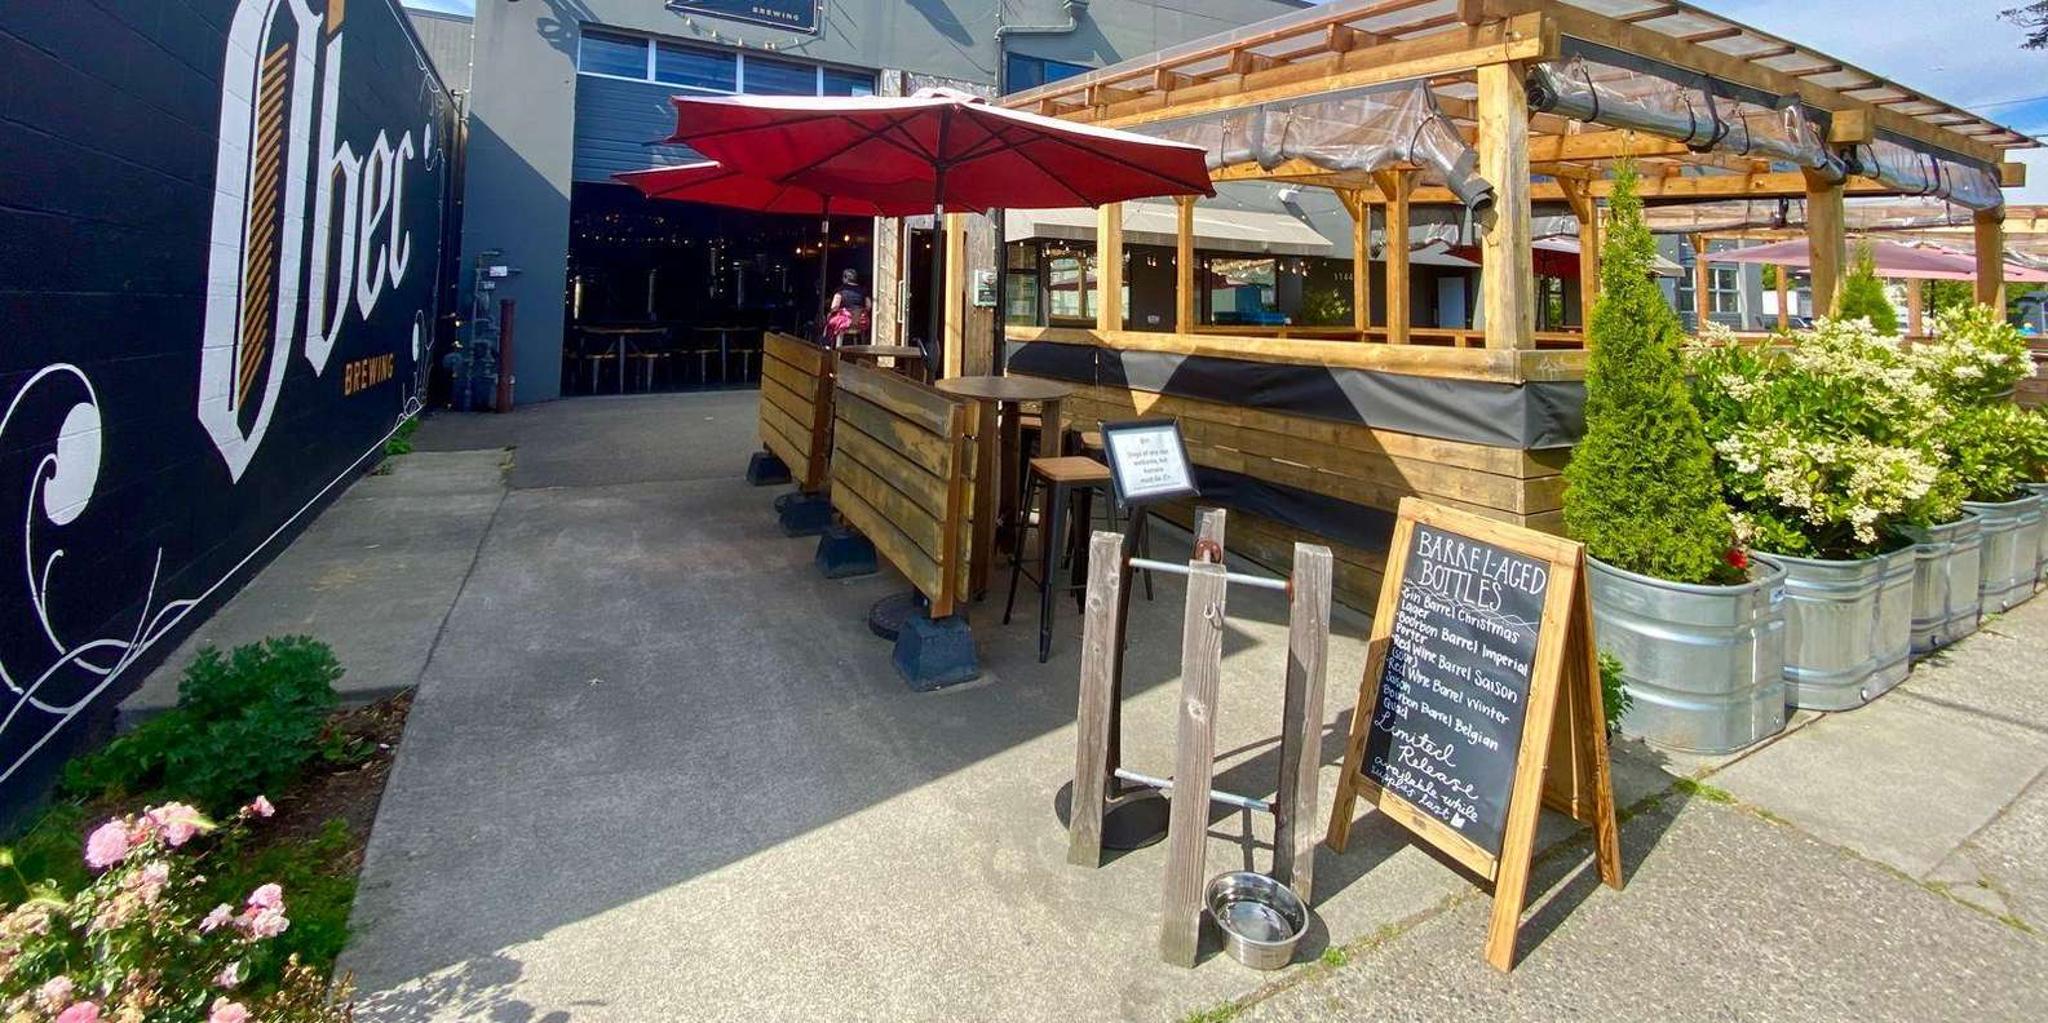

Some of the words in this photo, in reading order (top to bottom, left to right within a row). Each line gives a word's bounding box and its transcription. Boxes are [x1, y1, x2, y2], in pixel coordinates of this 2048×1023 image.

[752, 7, 799, 21] BREWING
[344, 353, 393, 396] BREWING
[1417, 530, 1547, 595] BARREL-AGED
[1420, 559, 1502, 612] BOTTLES
[1396, 622, 1429, 644] Porter
[1401, 598, 1430, 619] Lager
[1401, 586, 1421, 604] Gin
[1424, 594, 1456, 619] Barrel
[1458, 609, 1521, 644] Christmas
[1412, 642, 1437, 663] Wine
[1438, 654, 1471, 681] Barrel
[1474, 669, 1518, 703] Saison
[1441, 627, 1478, 653] Barrel
[1482, 643, 1529, 677] Imperial
[1383, 698, 1408, 720] Quad
[1388, 657, 1406, 677] Red
[1408, 667, 1431, 688] Wine
[1432, 679, 1463, 703] Barrel
[1467, 697, 1510, 724] Winter
[1374, 712, 1456, 767] Limited
[1384, 684, 1419, 710] Bourbon
[1421, 702, 1452, 727] Barrel
[1455, 718, 1499, 751] Belgian
[1398, 745, 1479, 800] Release
[1418, 794, 1450, 820] last
[1440, 795, 1478, 822] while
